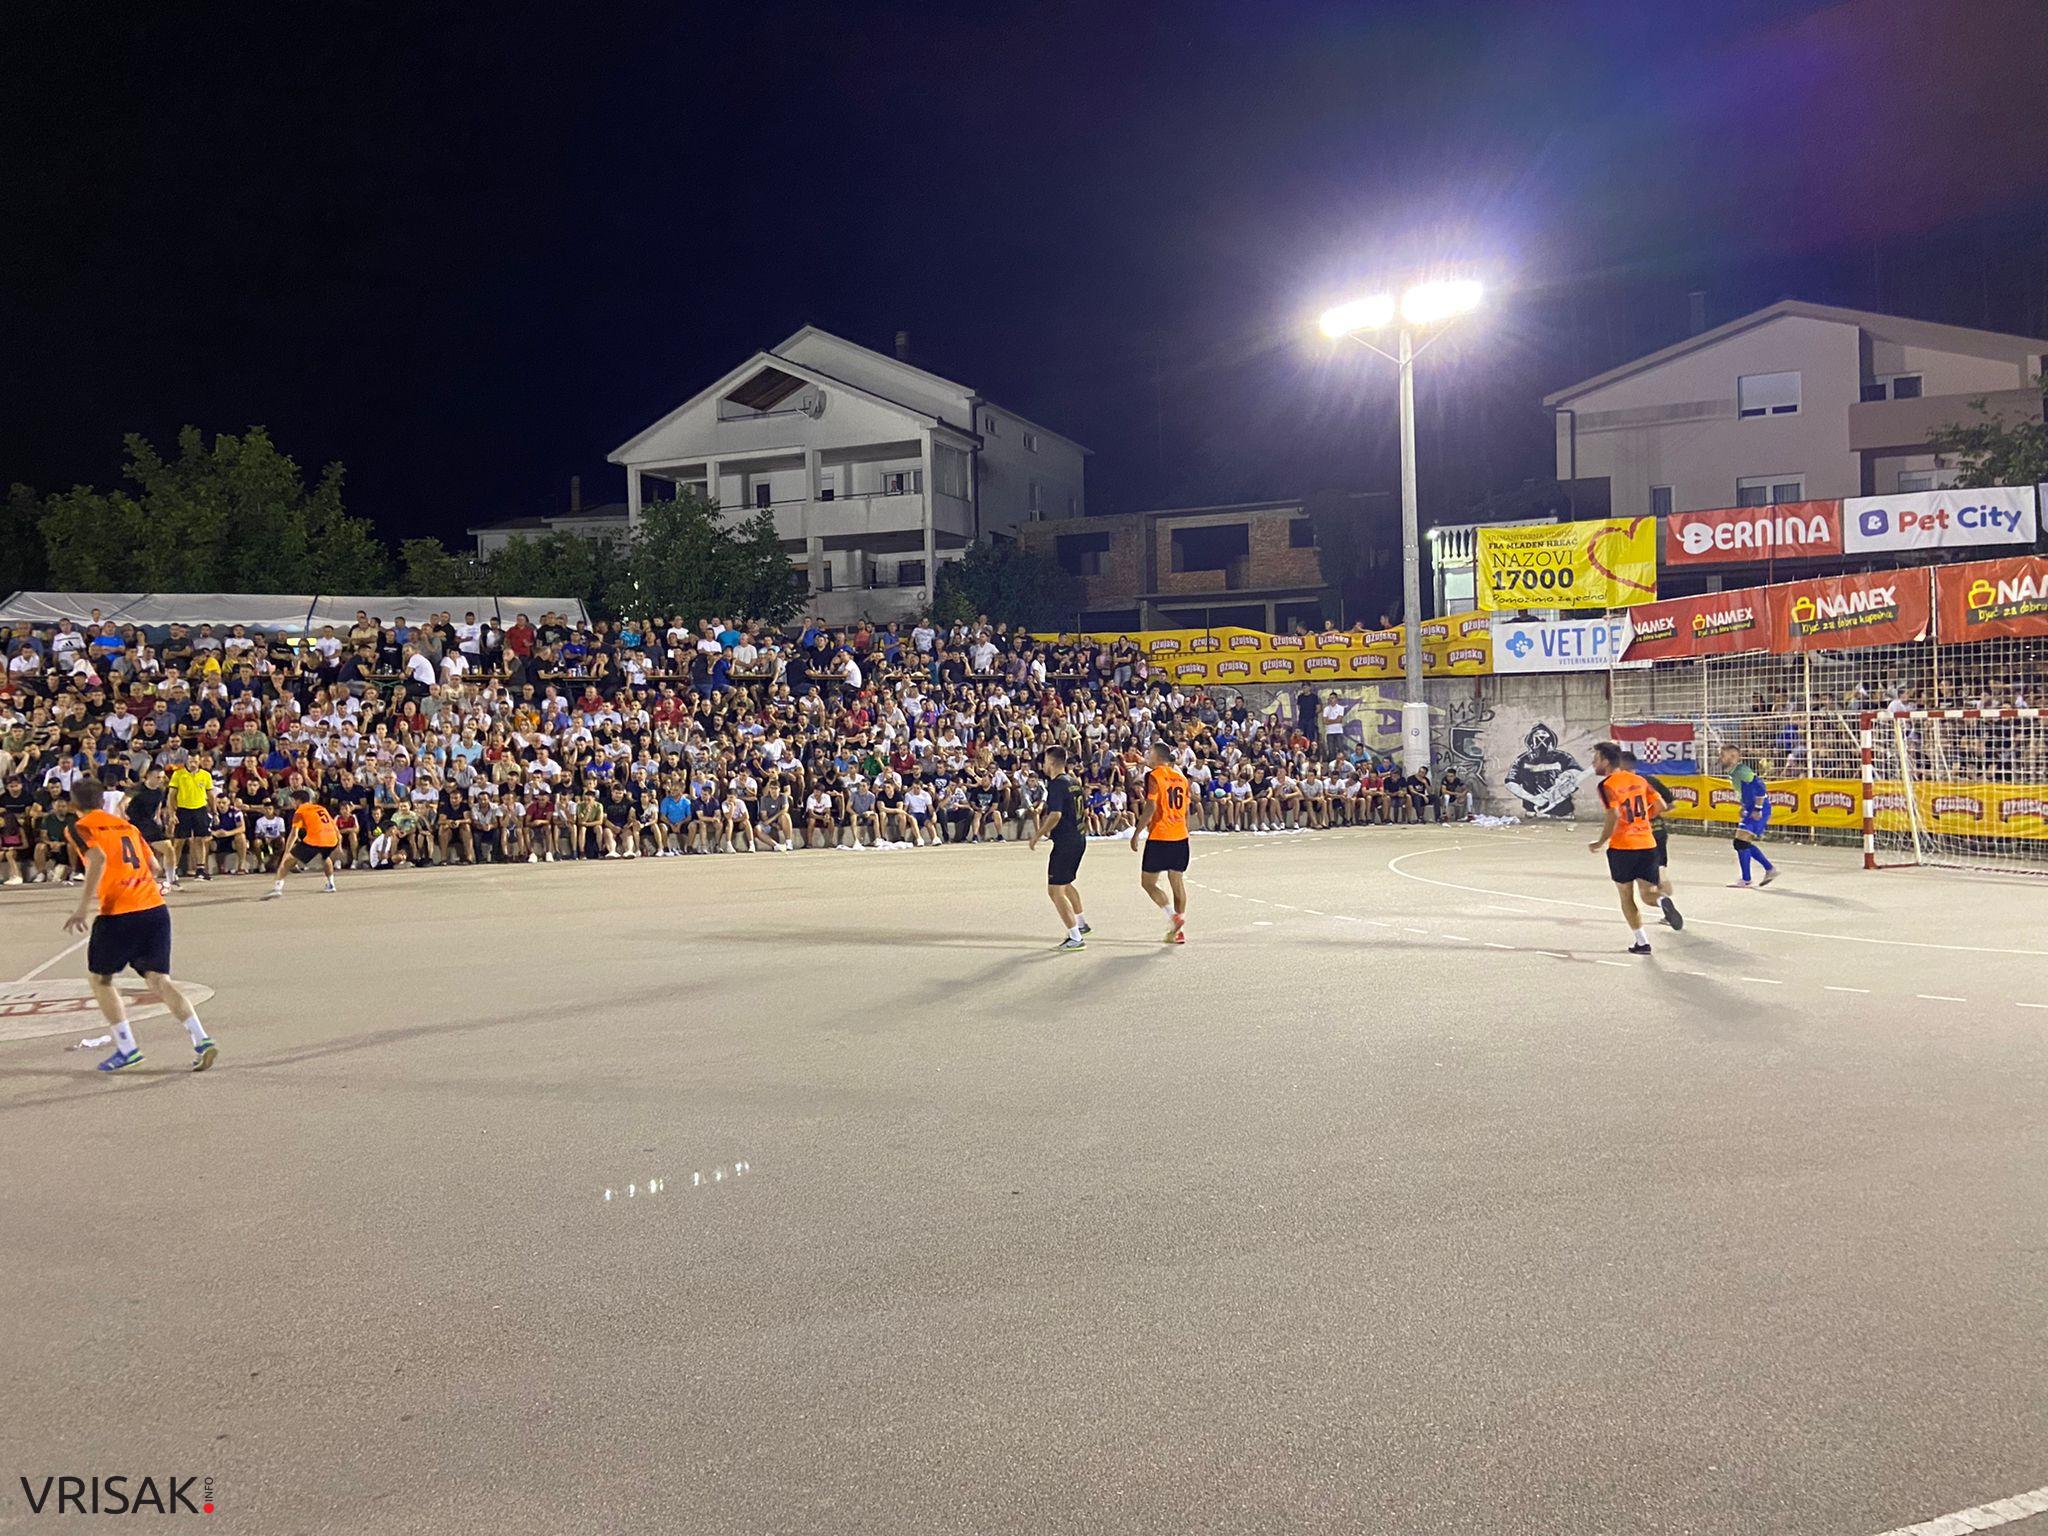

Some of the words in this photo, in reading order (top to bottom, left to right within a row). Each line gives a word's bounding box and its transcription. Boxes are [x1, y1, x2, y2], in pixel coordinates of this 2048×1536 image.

[1898, 508, 1949, 533] Pet
[1957, 505, 2022, 533] City
[1488, 542, 1504, 550] FRA
[1506, 541, 1544, 549] MLADEN
[1680, 514, 1831, 555] BERNINA
[1492, 551, 1574, 568] NAZOVI
[1492, 568, 1574, 591] 17000
[1492, 593, 1554, 604] Pomozimo
[1816, 586, 1896, 619] NAMEX
[1706, 607, 1754, 628] NAMEX
[1540, 628, 1586, 657] VET
[1592, 625, 1624, 655] PE
[1166, 786, 1183, 809] 16
[1620, 794, 1646, 824] 14
[316, 809, 330, 824] 5
[121, 836, 140, 869] 4
